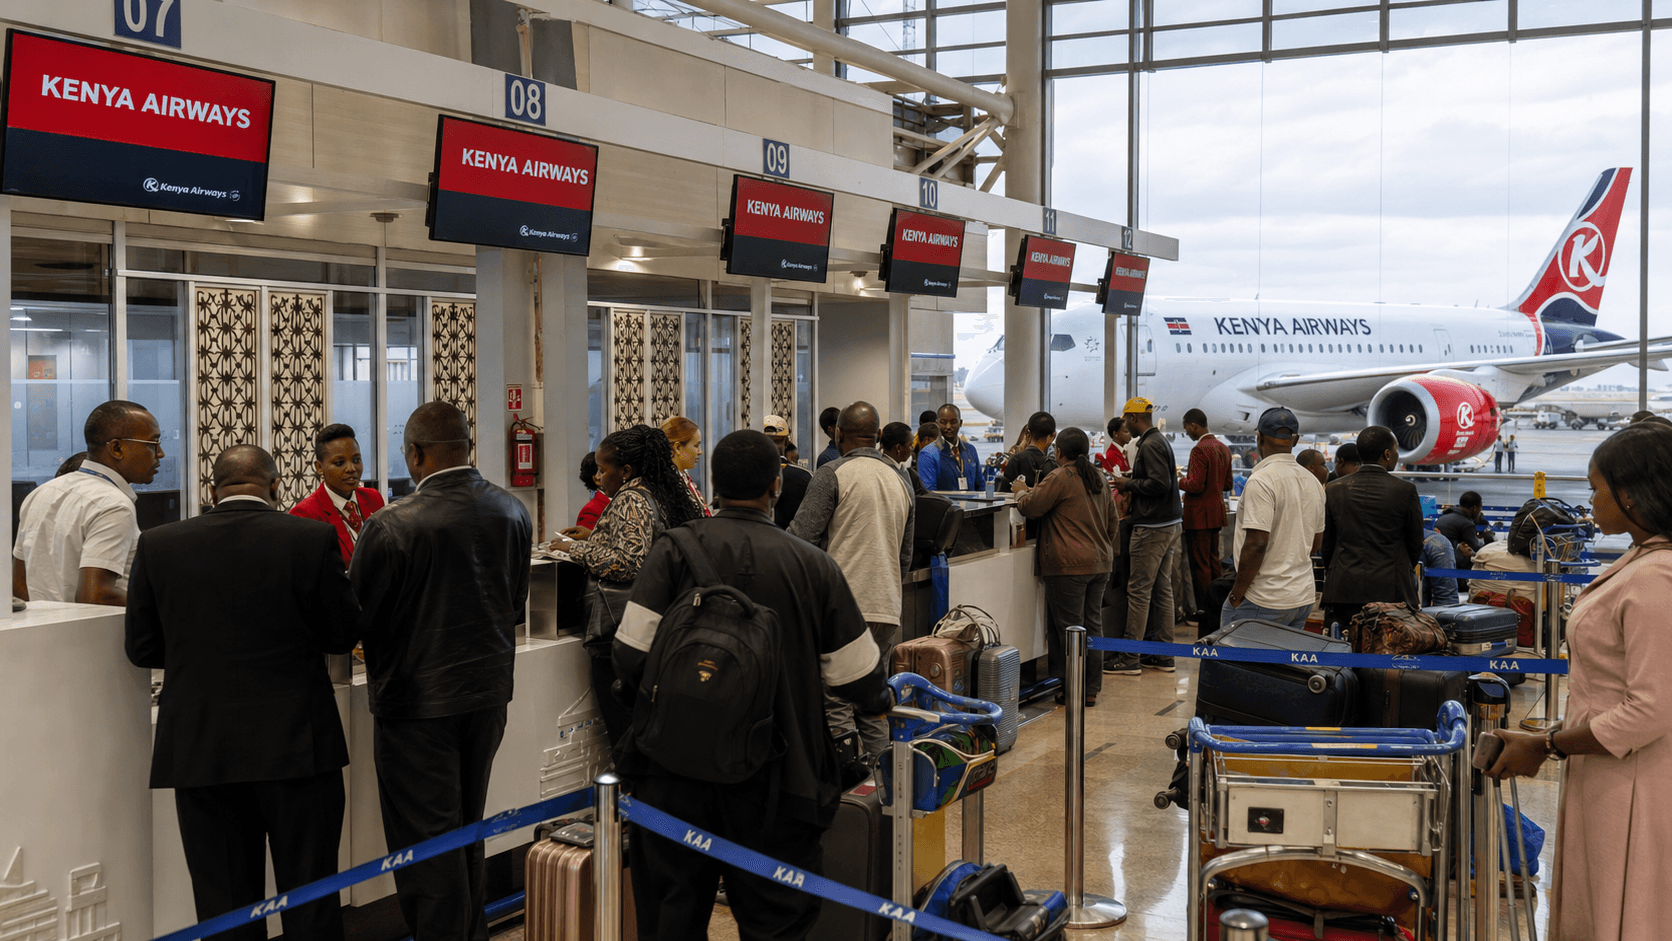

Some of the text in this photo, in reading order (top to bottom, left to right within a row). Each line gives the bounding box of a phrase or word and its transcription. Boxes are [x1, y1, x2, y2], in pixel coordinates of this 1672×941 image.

[41, 74, 251, 129] KENYA AIRWAYS
[510, 79, 541, 120] 08
[462, 148, 589, 185] KENYA AIRWAYS
[767, 142, 787, 174] 09
[160, 182, 189, 194] Kenya
[190, 186, 227, 198] Airways
[923, 181, 936, 207] 10
[747, 199, 825, 224] KENYA AIRWAYS
[1045, 210, 1055, 233] 11
[902, 228, 958, 248] KENYA AIRWAYS
[1123, 228, 1132, 250] 12
[1214, 317, 1372, 336] KENYA AIRWAYS
[1193, 647, 1218, 658] KAA
[1291, 652, 1318, 664] KAA
[1489, 660, 1520, 671] KAA
[683, 829, 712, 851] KAA
[381, 850, 414, 871] KAA
[250, 895, 288, 919] KAA
[878, 902, 916, 923] KAA
